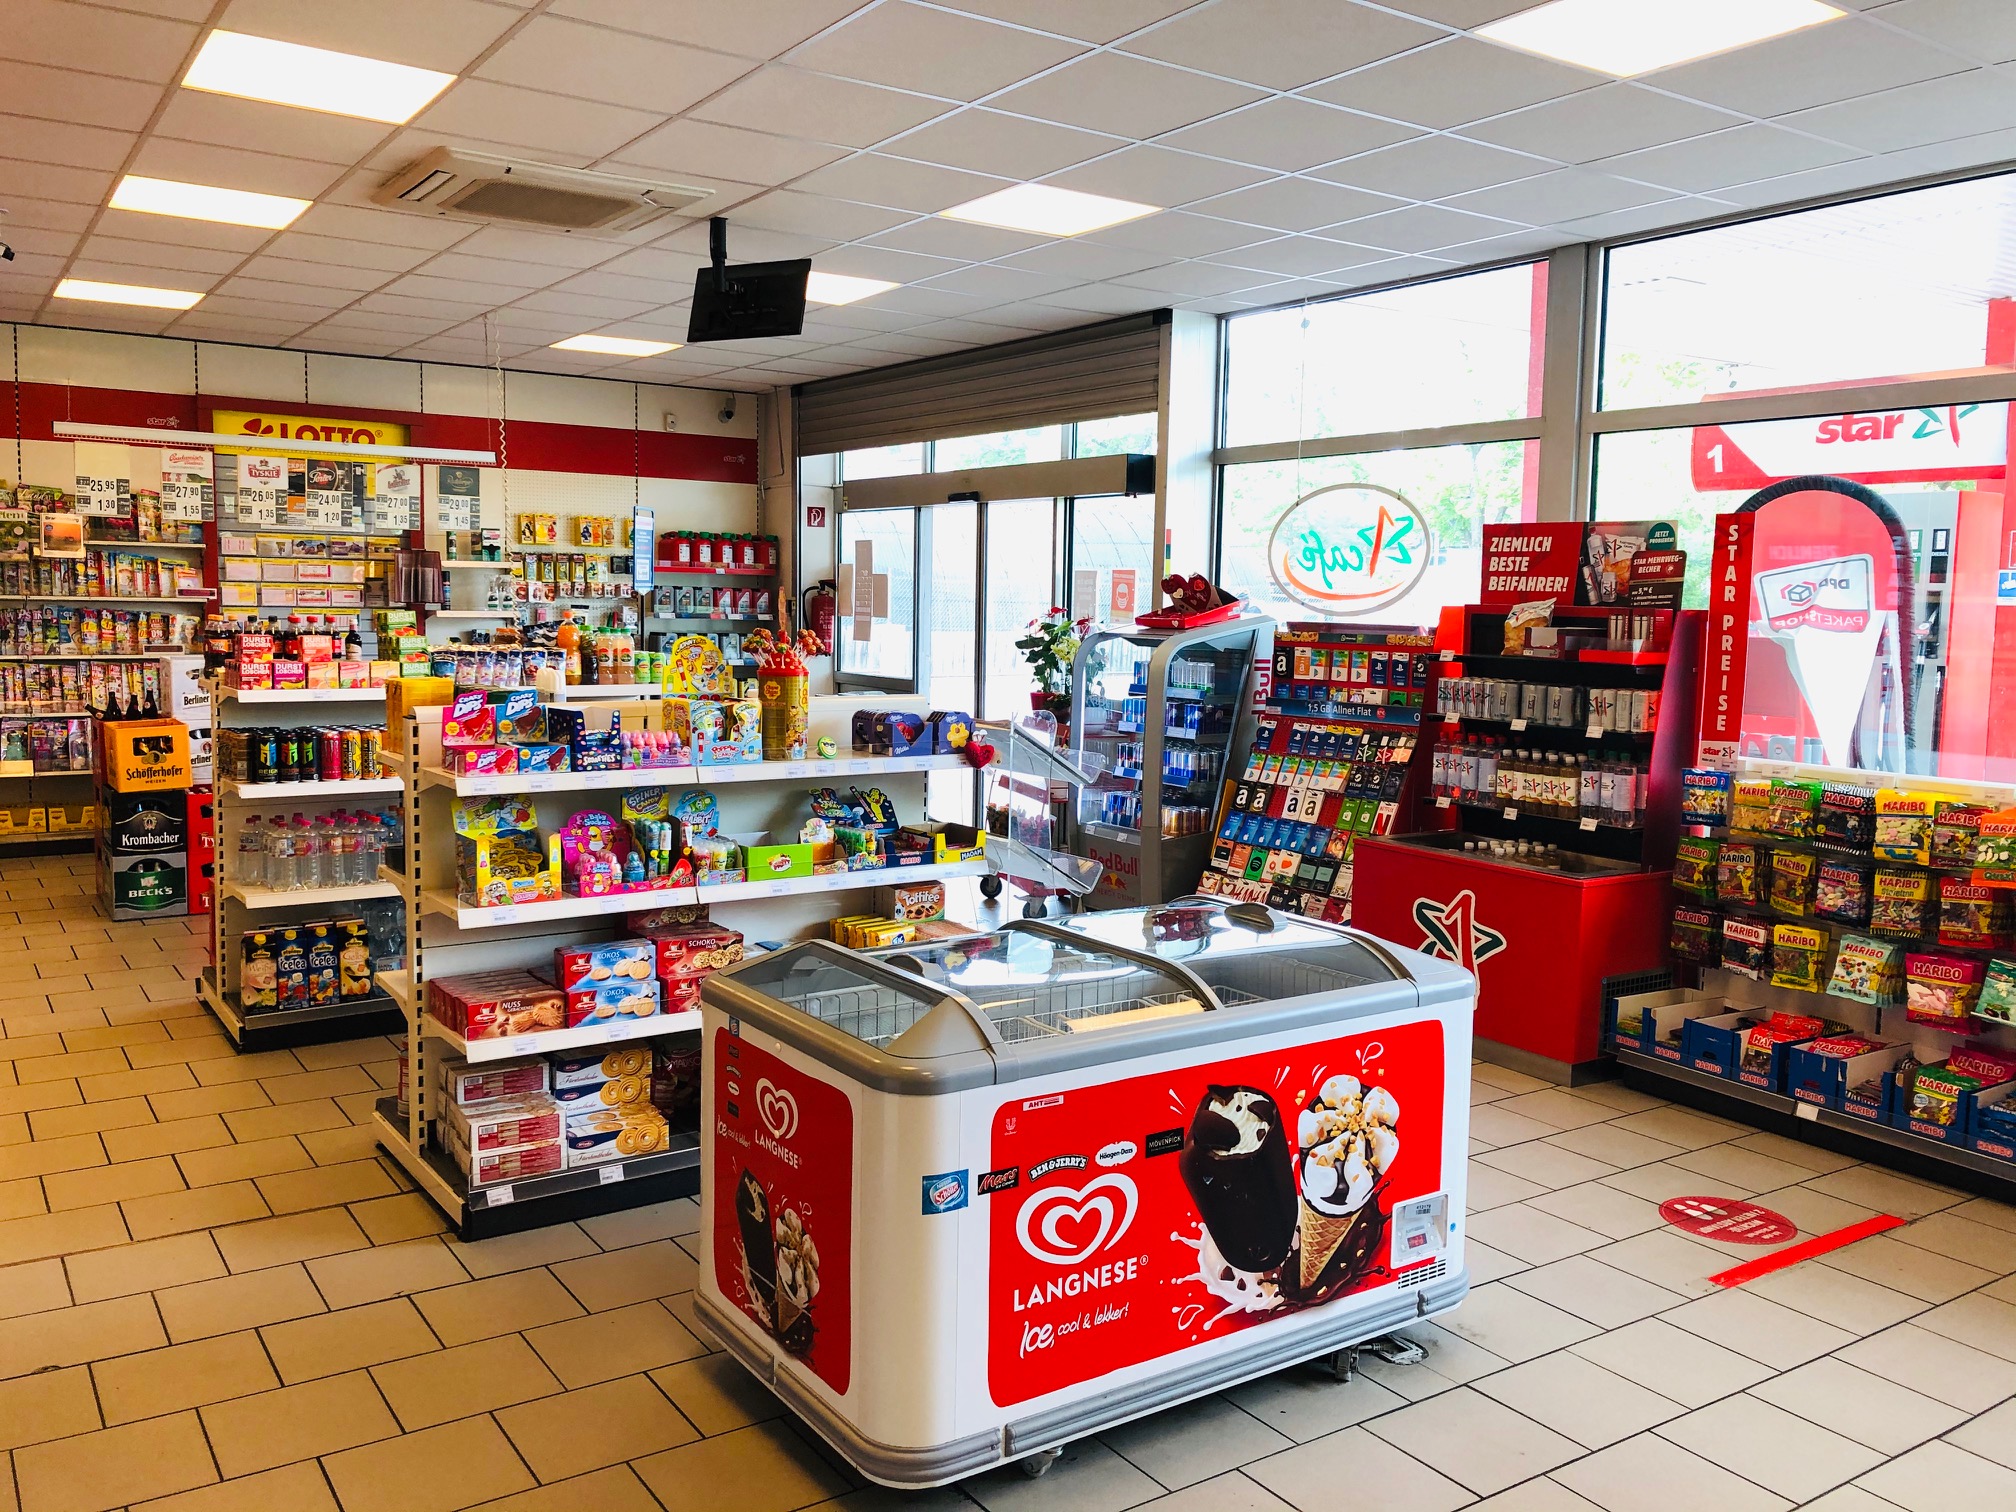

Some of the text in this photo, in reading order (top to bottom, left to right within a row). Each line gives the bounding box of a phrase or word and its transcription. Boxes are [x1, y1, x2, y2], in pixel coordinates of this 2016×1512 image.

[1815, 413, 1905, 445] star
[1706, 444, 1724, 473] 1
[251, 469, 278, 478] TYSKIE
[1654, 530, 1670, 538] JETZT
[1489, 536, 1553, 553] ZIEMLICH
[1489, 556, 1529, 572] BESTE
[1633, 555, 1683, 566] STAR MEHRWEG-
[1638, 565, 1662, 574] BECHER
[1488, 576, 1569, 593] BEIFAHRER!
[388, 611, 412, 619] DURST
[1715, 524, 1740, 732] STAR PREISE
[1254, 658, 1272, 706] Bull
[183, 694, 210, 707] Berliner
[505, 699, 535, 716] DIPS
[452, 700, 484, 718] DIPS
[1320, 703, 1331, 713] GB
[1332, 705, 1355, 716] Allnet
[1356, 706, 1372, 717] Flat
[894, 746, 910, 755] Milka
[1702, 746, 1721, 756] star
[190, 755, 212, 766] erliner
[476, 755, 498, 769] DIPS
[582, 753, 617, 766] SMARTIES
[126, 766, 184, 783] Schöfferhofer
[1684, 774, 1718, 786] HARIBO
[1773, 786, 1811, 800] HARIBO
[1823, 791, 1864, 807] HARIBO
[1882, 801, 1926, 812] HARIBO
[122, 831, 180, 847] Krombacher
[961, 848, 983, 860] MAOAM
[1679, 844, 1709, 859] HARIBO
[1720, 853, 1751, 864] HARIBO
[900, 856, 921, 865] HARIBO
[1114, 851, 1138, 876] Bull
[1776, 857, 1807, 873] HARIBO
[1822, 866, 1860, 882] HARIBO
[1878, 877, 1921, 890] HARIBO
[128, 885, 174, 898] BECK'S
[1942, 885, 1989, 899] HARIBO
[903, 892, 940, 907] Toffifee
[1674, 909, 1709, 926] HARIBO
[1726, 923, 1760, 939] HARIBO
[688, 938, 716, 948] SCHOKO
[1778, 933, 1816, 947] HARIBO
[597, 951, 621, 960] KOKOS
[1844, 942, 1885, 959] HARIBO
[1913, 961, 1963, 981] HARIBO
[601, 988, 625, 997] KOKOS
[501, 1000, 522, 1009] NUSS
[1615, 1034, 1641, 1049] HARIBO
[1814, 1040, 1855, 1055] HARIBO
[1654, 1046, 1681, 1061] HARIBO
[1694, 1059, 1722, 1075] HARIBO
[1956, 1055, 2006, 1078] HARIBO
[1739, 1072, 1769, 1087] HARIBO
[1795, 1088, 1826, 1104] HARIBO
[1028, 1100, 1044, 1109] AHT
[1844, 1102, 1878, 1119] HARIBO
[1909, 1120, 1946, 1139] HARIBO
[1148, 1135, 1183, 1149] MÖVENPICK
[1976, 1140, 2014, 1159] HARIBO
[978, 1168, 1018, 1194] Mars
[1082, 1313, 1092, 1329] &
